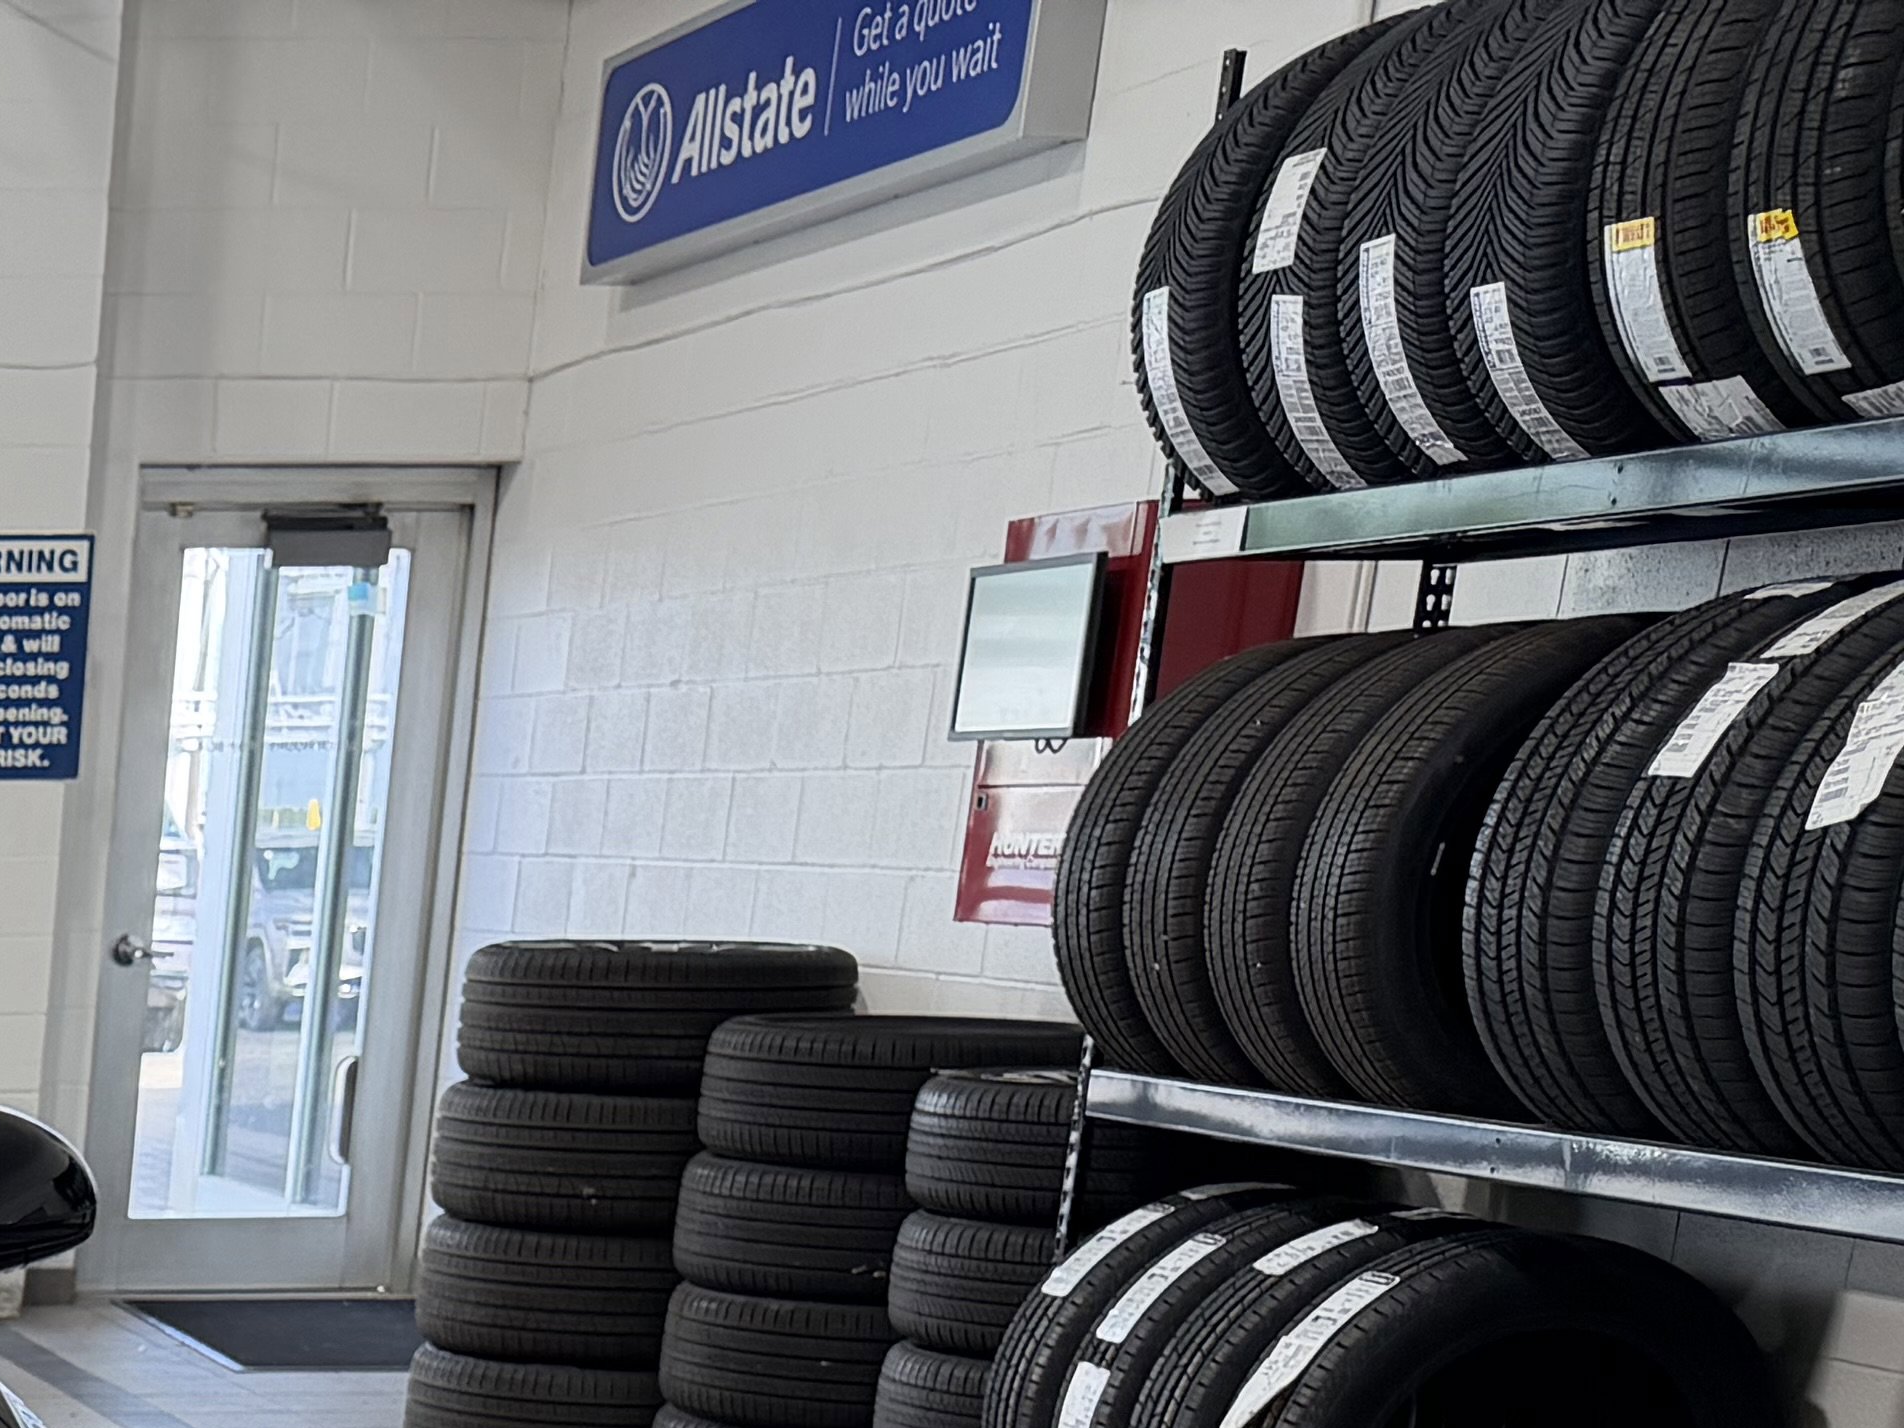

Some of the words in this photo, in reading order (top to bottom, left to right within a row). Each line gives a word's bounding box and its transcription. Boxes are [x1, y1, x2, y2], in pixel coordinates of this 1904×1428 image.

[853, 1, 892, 56] Get
[895, 4, 909, 40] a
[845, 60, 900, 122] while
[902, 54, 945, 113] you
[952, 22, 1002, 82] wait
[671, 55, 817, 184] Allstate
[29, 587, 49, 607] is
[53, 591, 81, 607] on
[0, 634, 17, 654] &
[22, 634, 61, 654] will
[8, 725, 68, 745] YOUR
